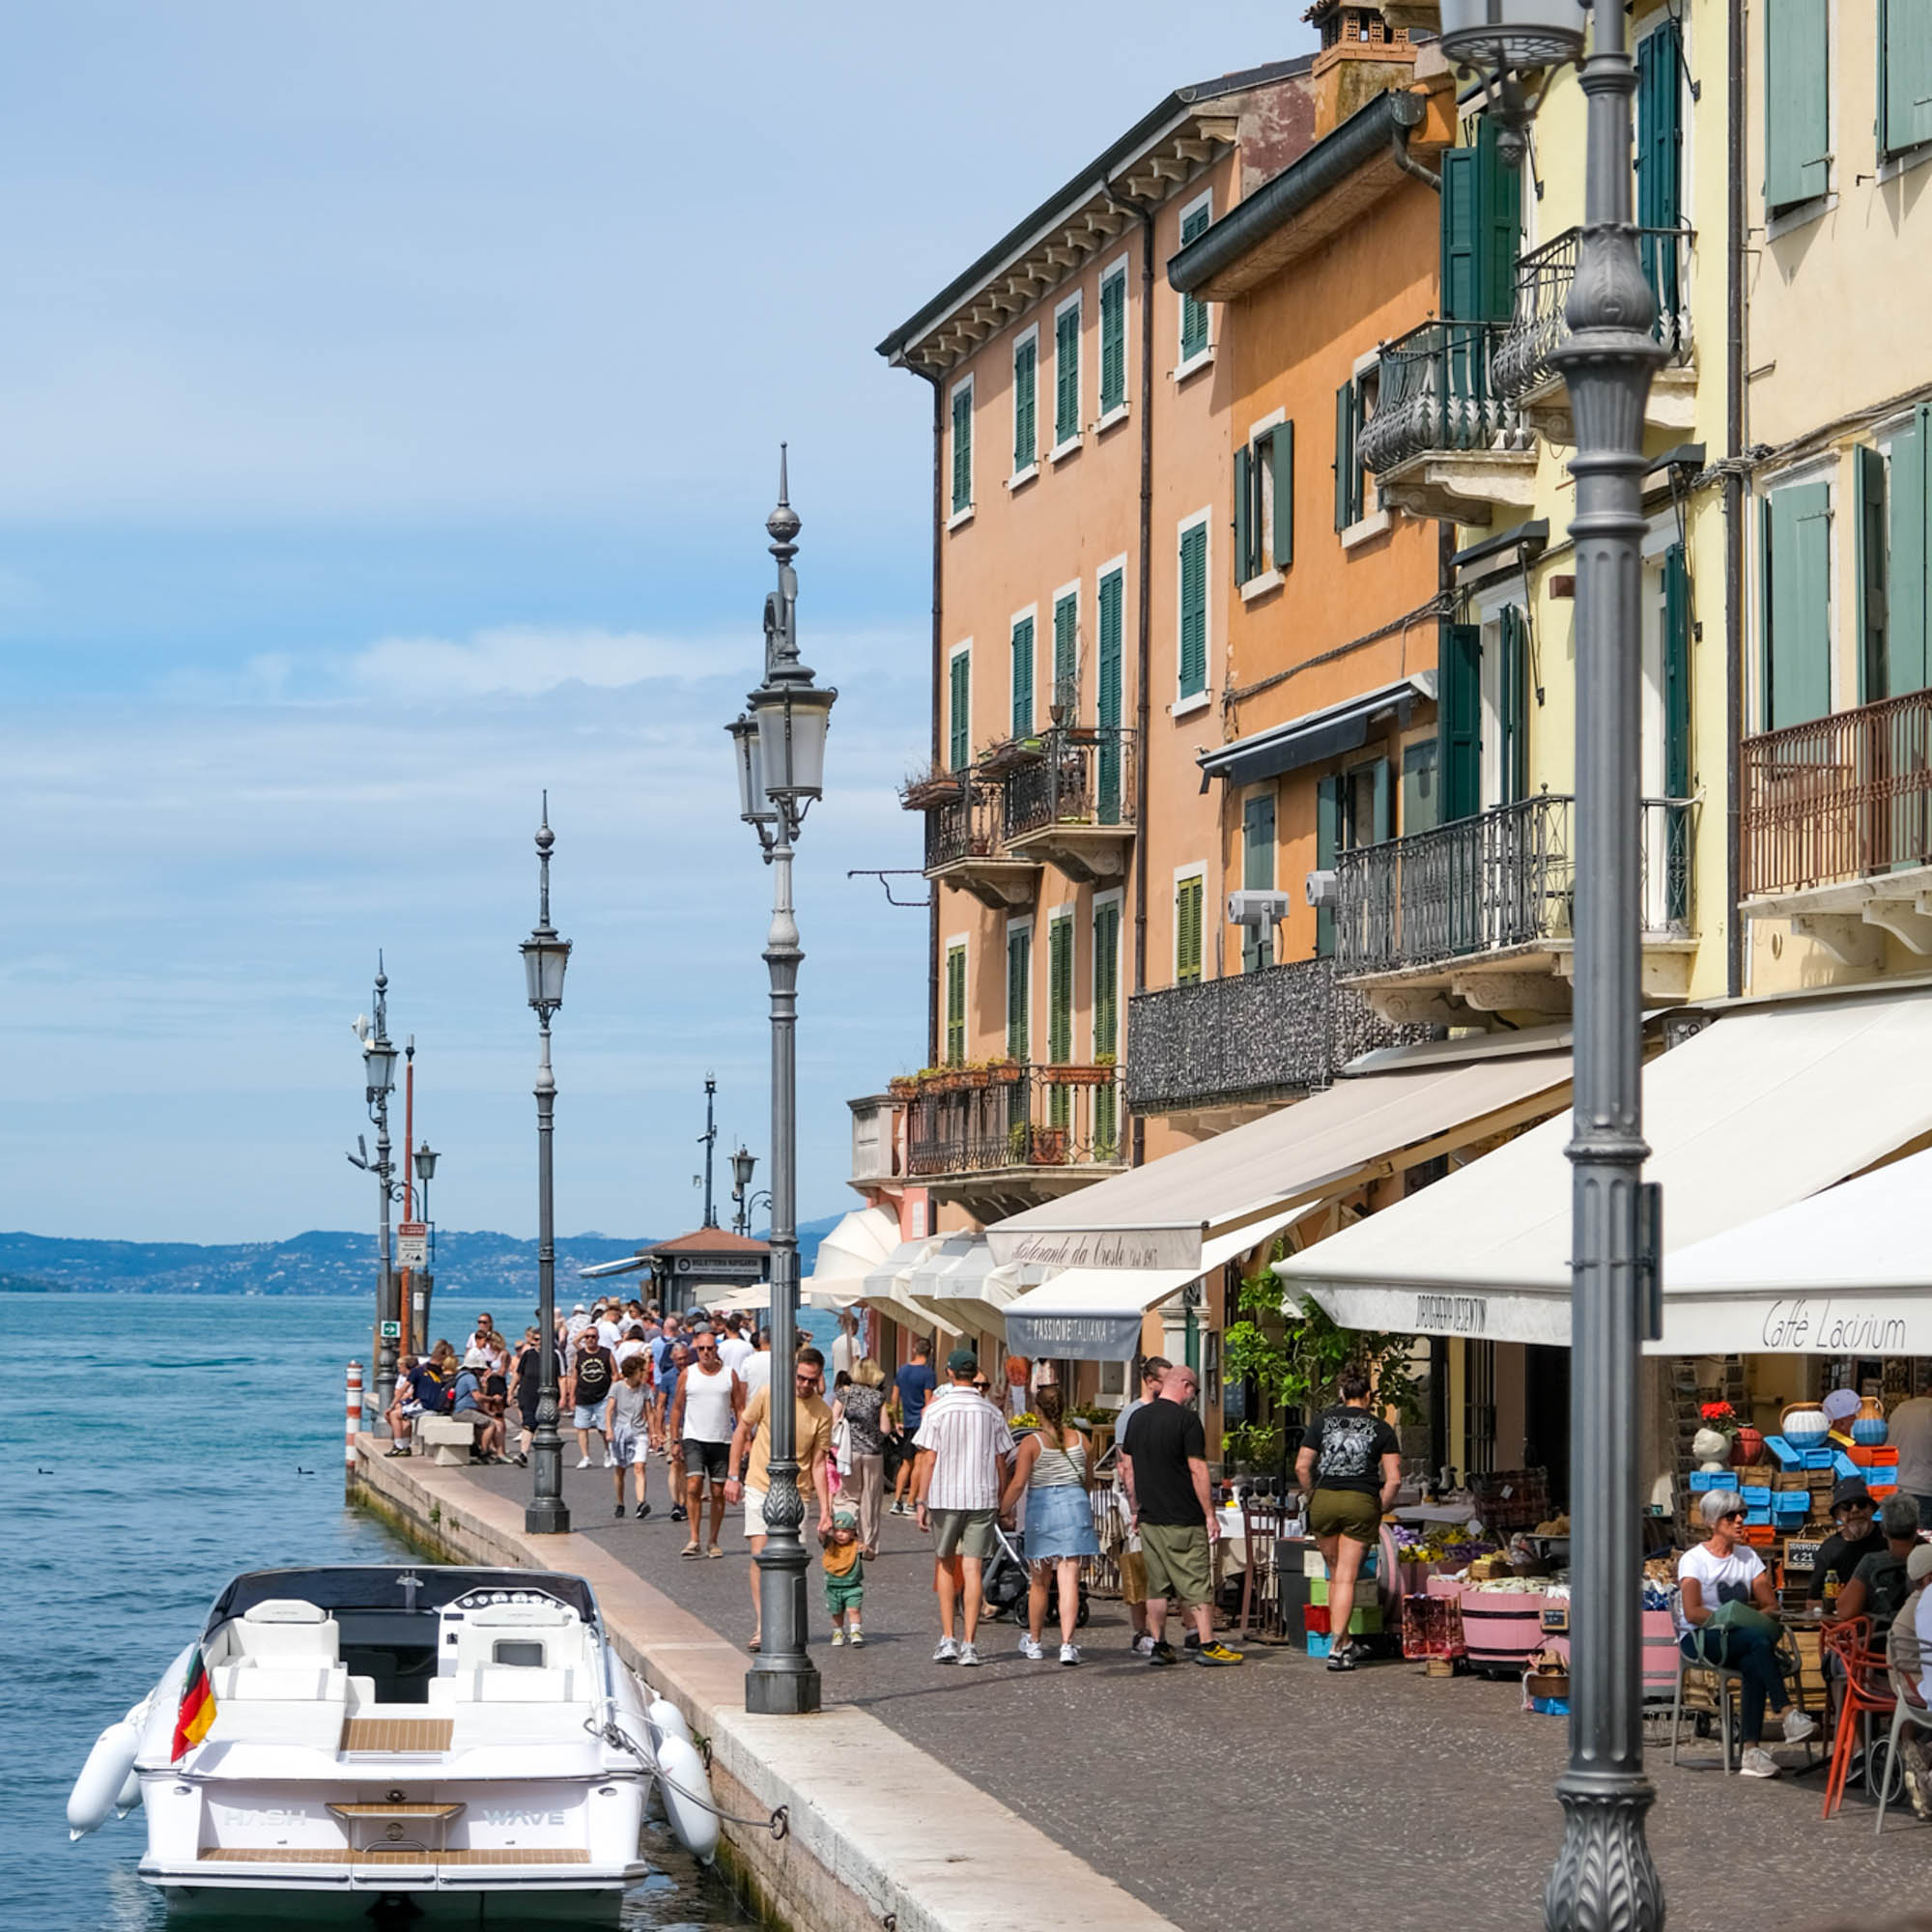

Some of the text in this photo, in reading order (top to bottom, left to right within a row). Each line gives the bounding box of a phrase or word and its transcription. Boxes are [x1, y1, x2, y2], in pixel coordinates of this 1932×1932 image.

[1071, 1236, 1089, 1265] da
[1762, 1297, 1907, 1350] Caffè Lacisium
[224, 1809, 306, 1826] HASH
[482, 1809, 565, 1826] WAVE
